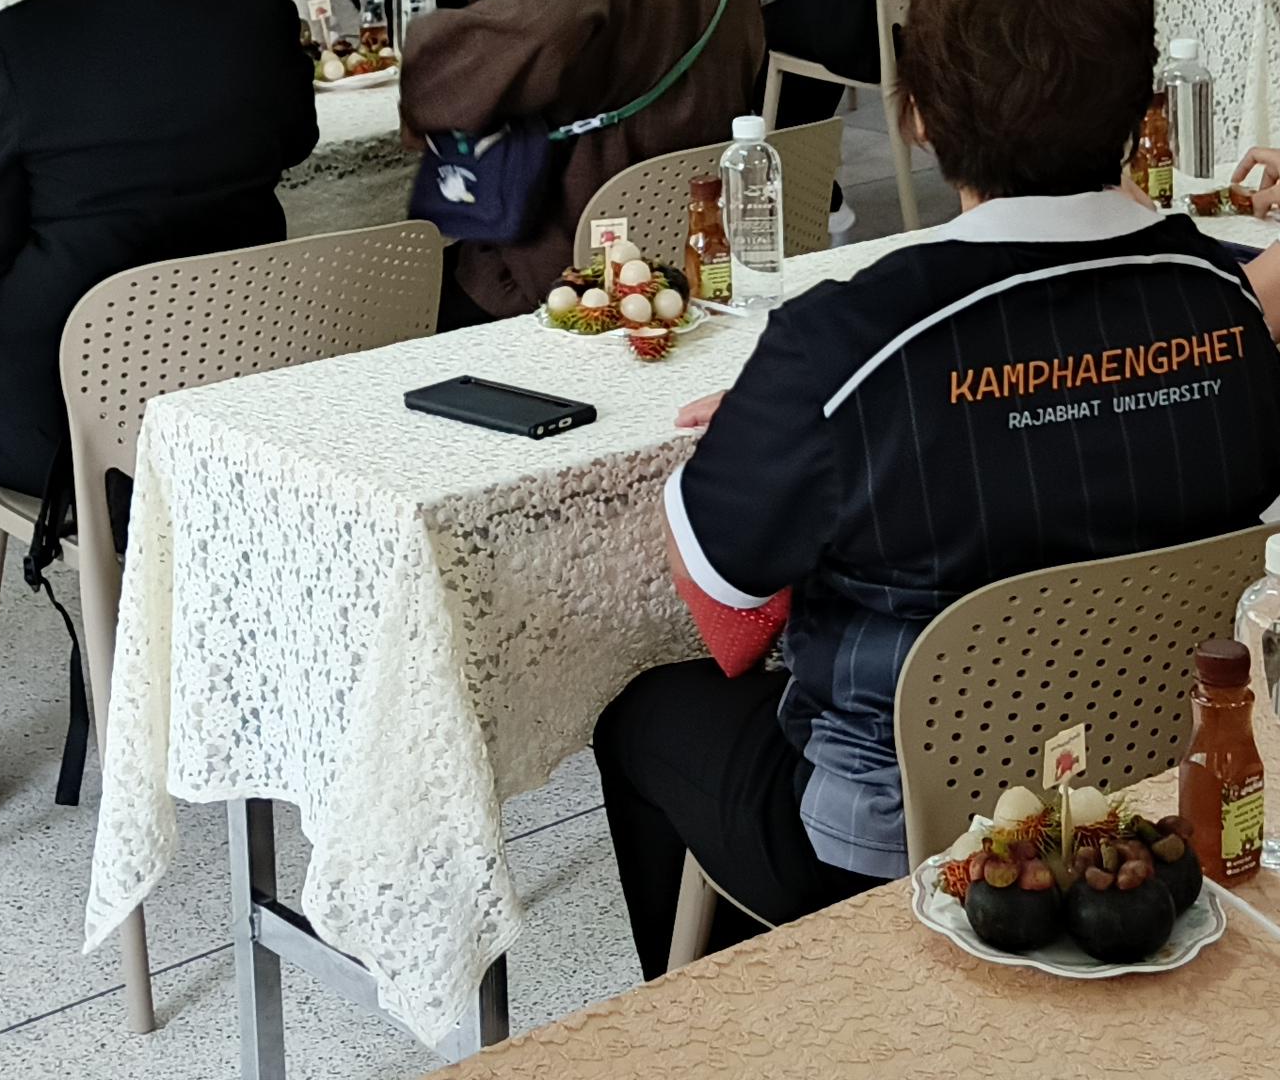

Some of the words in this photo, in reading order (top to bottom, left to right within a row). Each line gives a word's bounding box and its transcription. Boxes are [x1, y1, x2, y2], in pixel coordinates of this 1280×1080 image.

[950, 326, 1245, 404] KAMPHAENGPHET
[1008, 400, 1102, 430] RAJABHAT
[1113, 379, 1223, 414] UNIVERSITY
